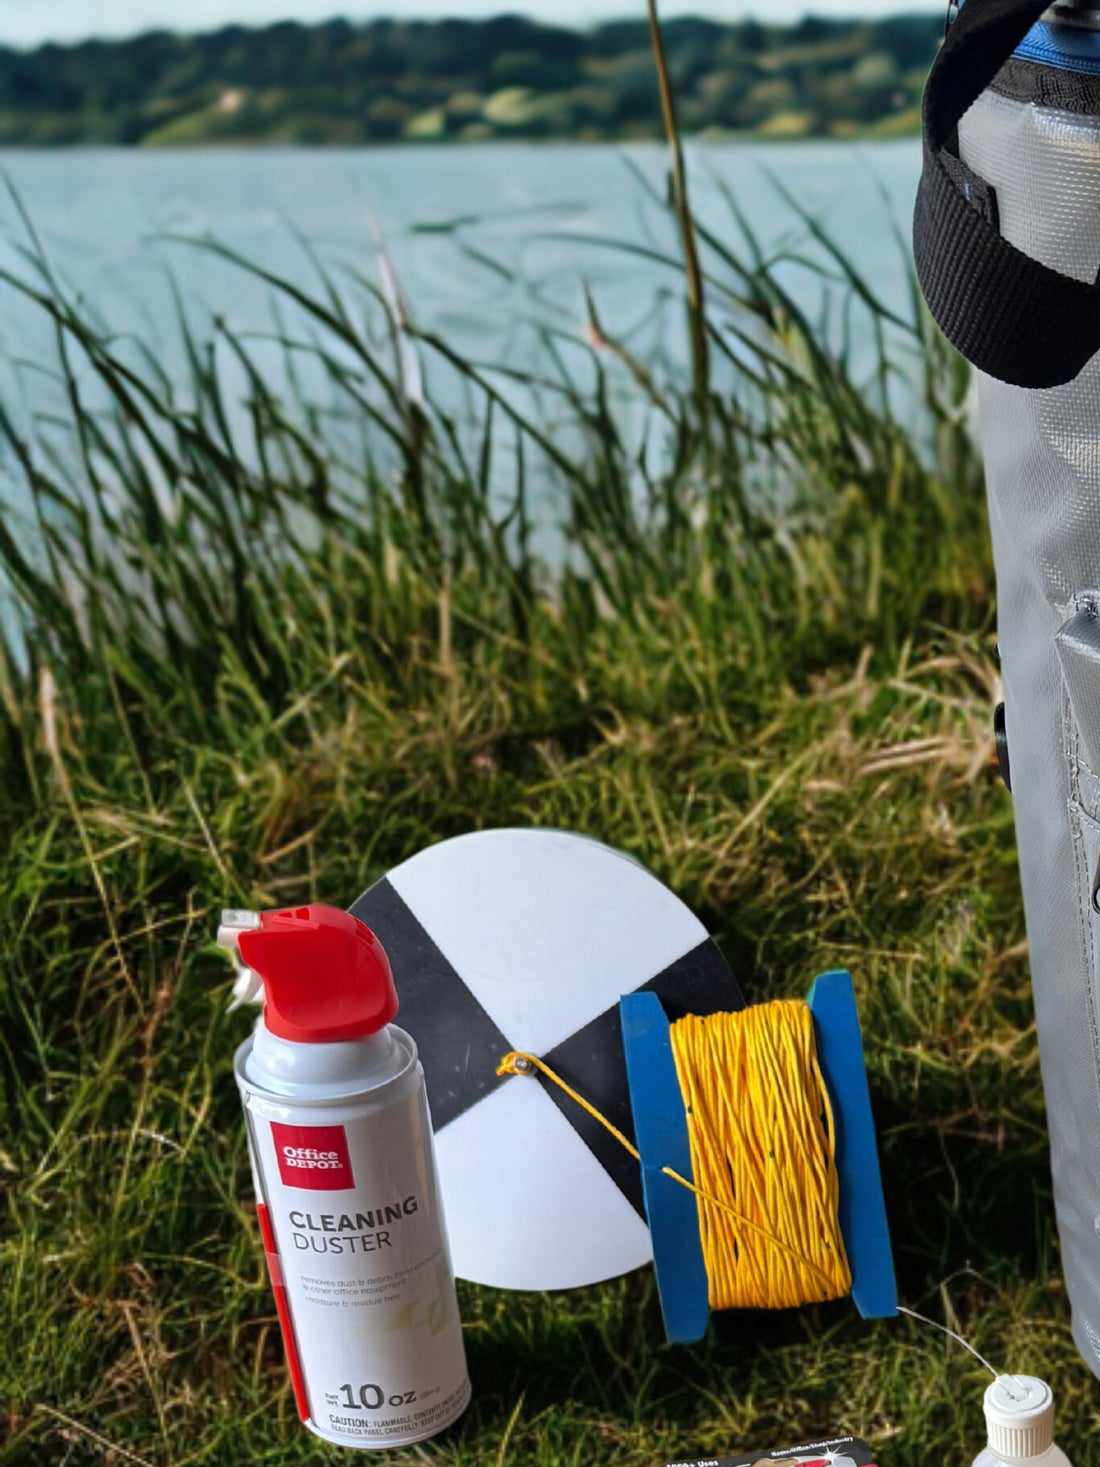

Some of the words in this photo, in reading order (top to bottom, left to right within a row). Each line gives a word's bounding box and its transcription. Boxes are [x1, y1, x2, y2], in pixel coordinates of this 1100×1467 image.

[282, 1146, 338, 1161] Office
[289, 1196, 419, 1232] CLEANING
[293, 1231, 393, 1254] DUSTER
[340, 1383, 385, 1410] 10
[388, 1390, 417, 1407] oz
[329, 1414, 372, 1428] CAUTION:
